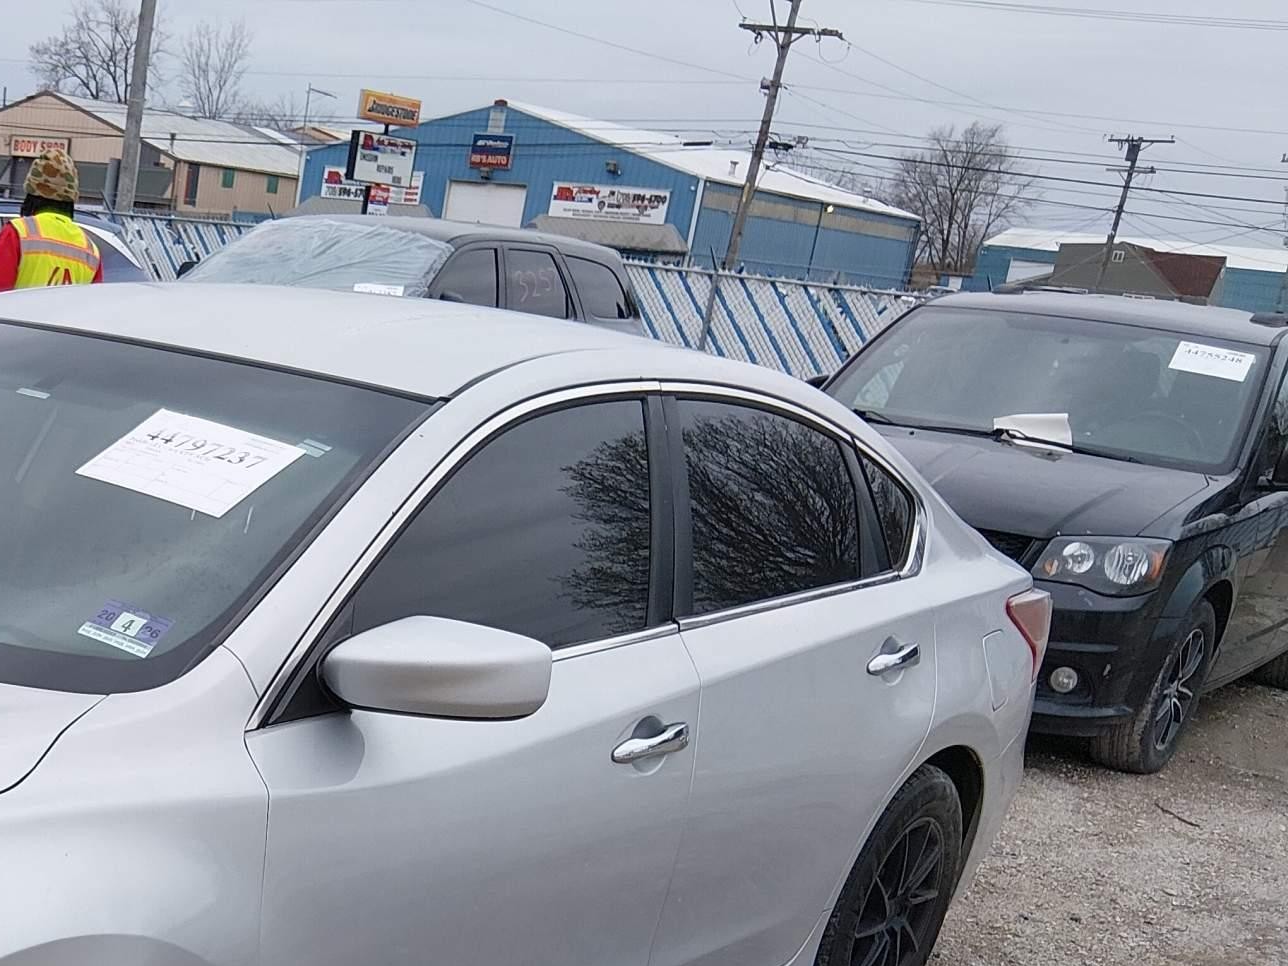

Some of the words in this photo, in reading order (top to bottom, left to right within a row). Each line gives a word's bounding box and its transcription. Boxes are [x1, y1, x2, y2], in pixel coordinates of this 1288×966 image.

[14, 139, 37, 152] BODY
[487, 155, 508, 165] AUTO
[146, 429, 267, 469] 44797237
[121, 619, 136, 632] 4
